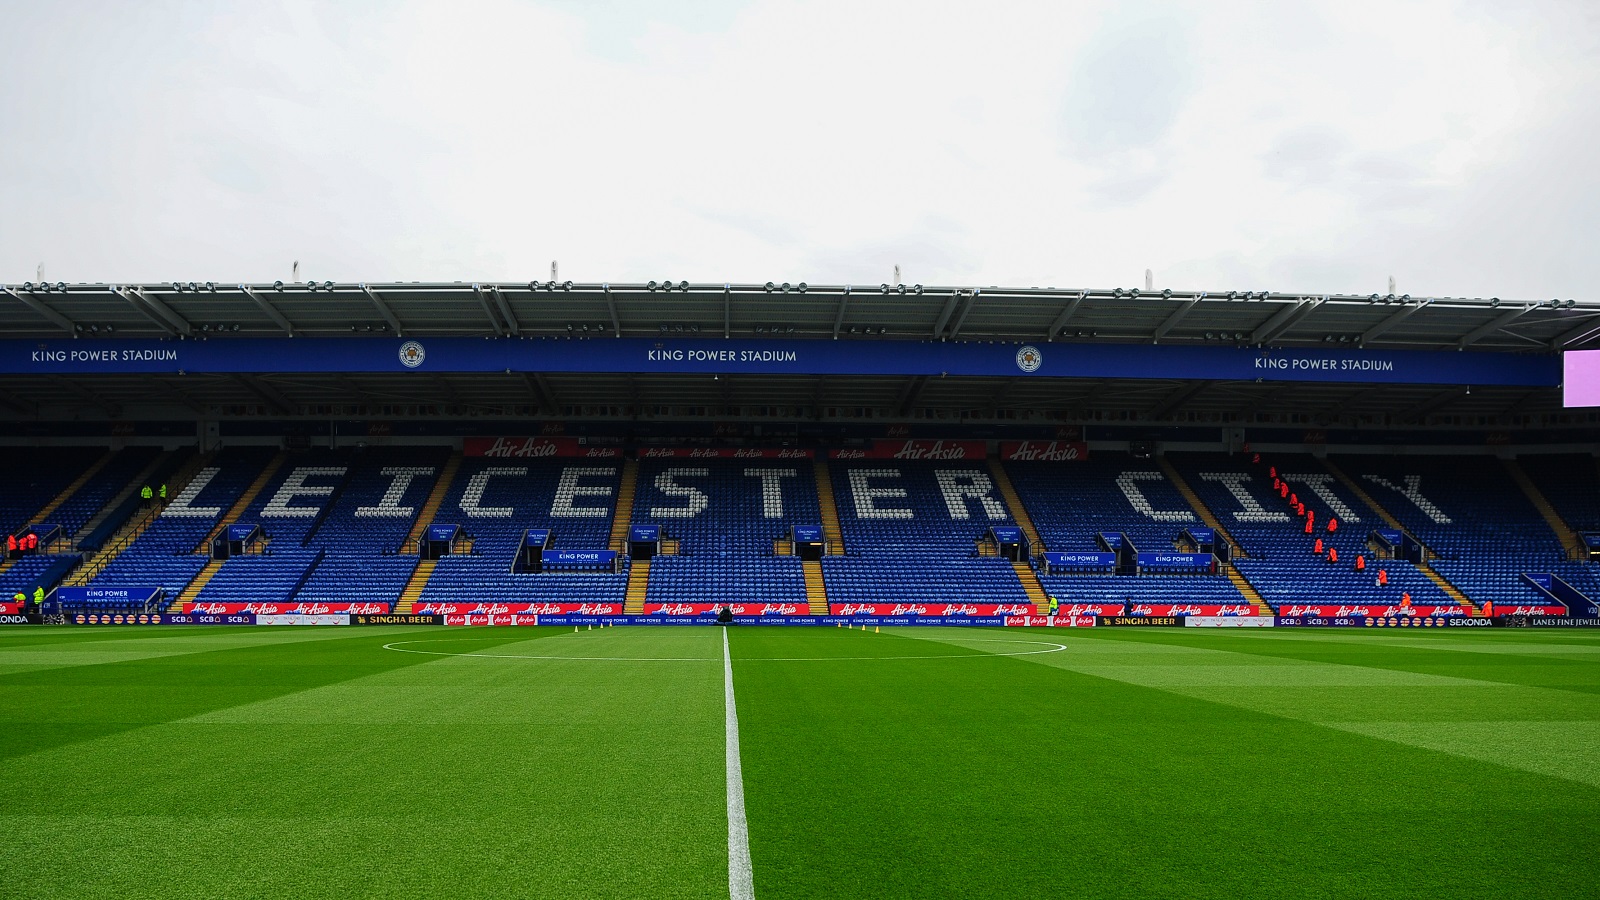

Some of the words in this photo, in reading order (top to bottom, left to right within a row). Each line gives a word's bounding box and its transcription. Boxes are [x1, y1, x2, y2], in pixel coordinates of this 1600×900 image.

[33, 351, 67, 361] KING
[71, 351, 118, 361] POWER
[122, 350, 177, 360] STADIUM
[648, 351, 684, 361] KING
[688, 351, 736, 361] POWER
[741, 351, 797, 361] STADIUM
[1255, 358, 1288, 369] KING
[1292, 359, 1337, 370] POWER
[1341, 360, 1393, 371] STADIUM
[161, 467, 1007, 520] LEICESTER
[1116, 471, 1453, 523] CITY
